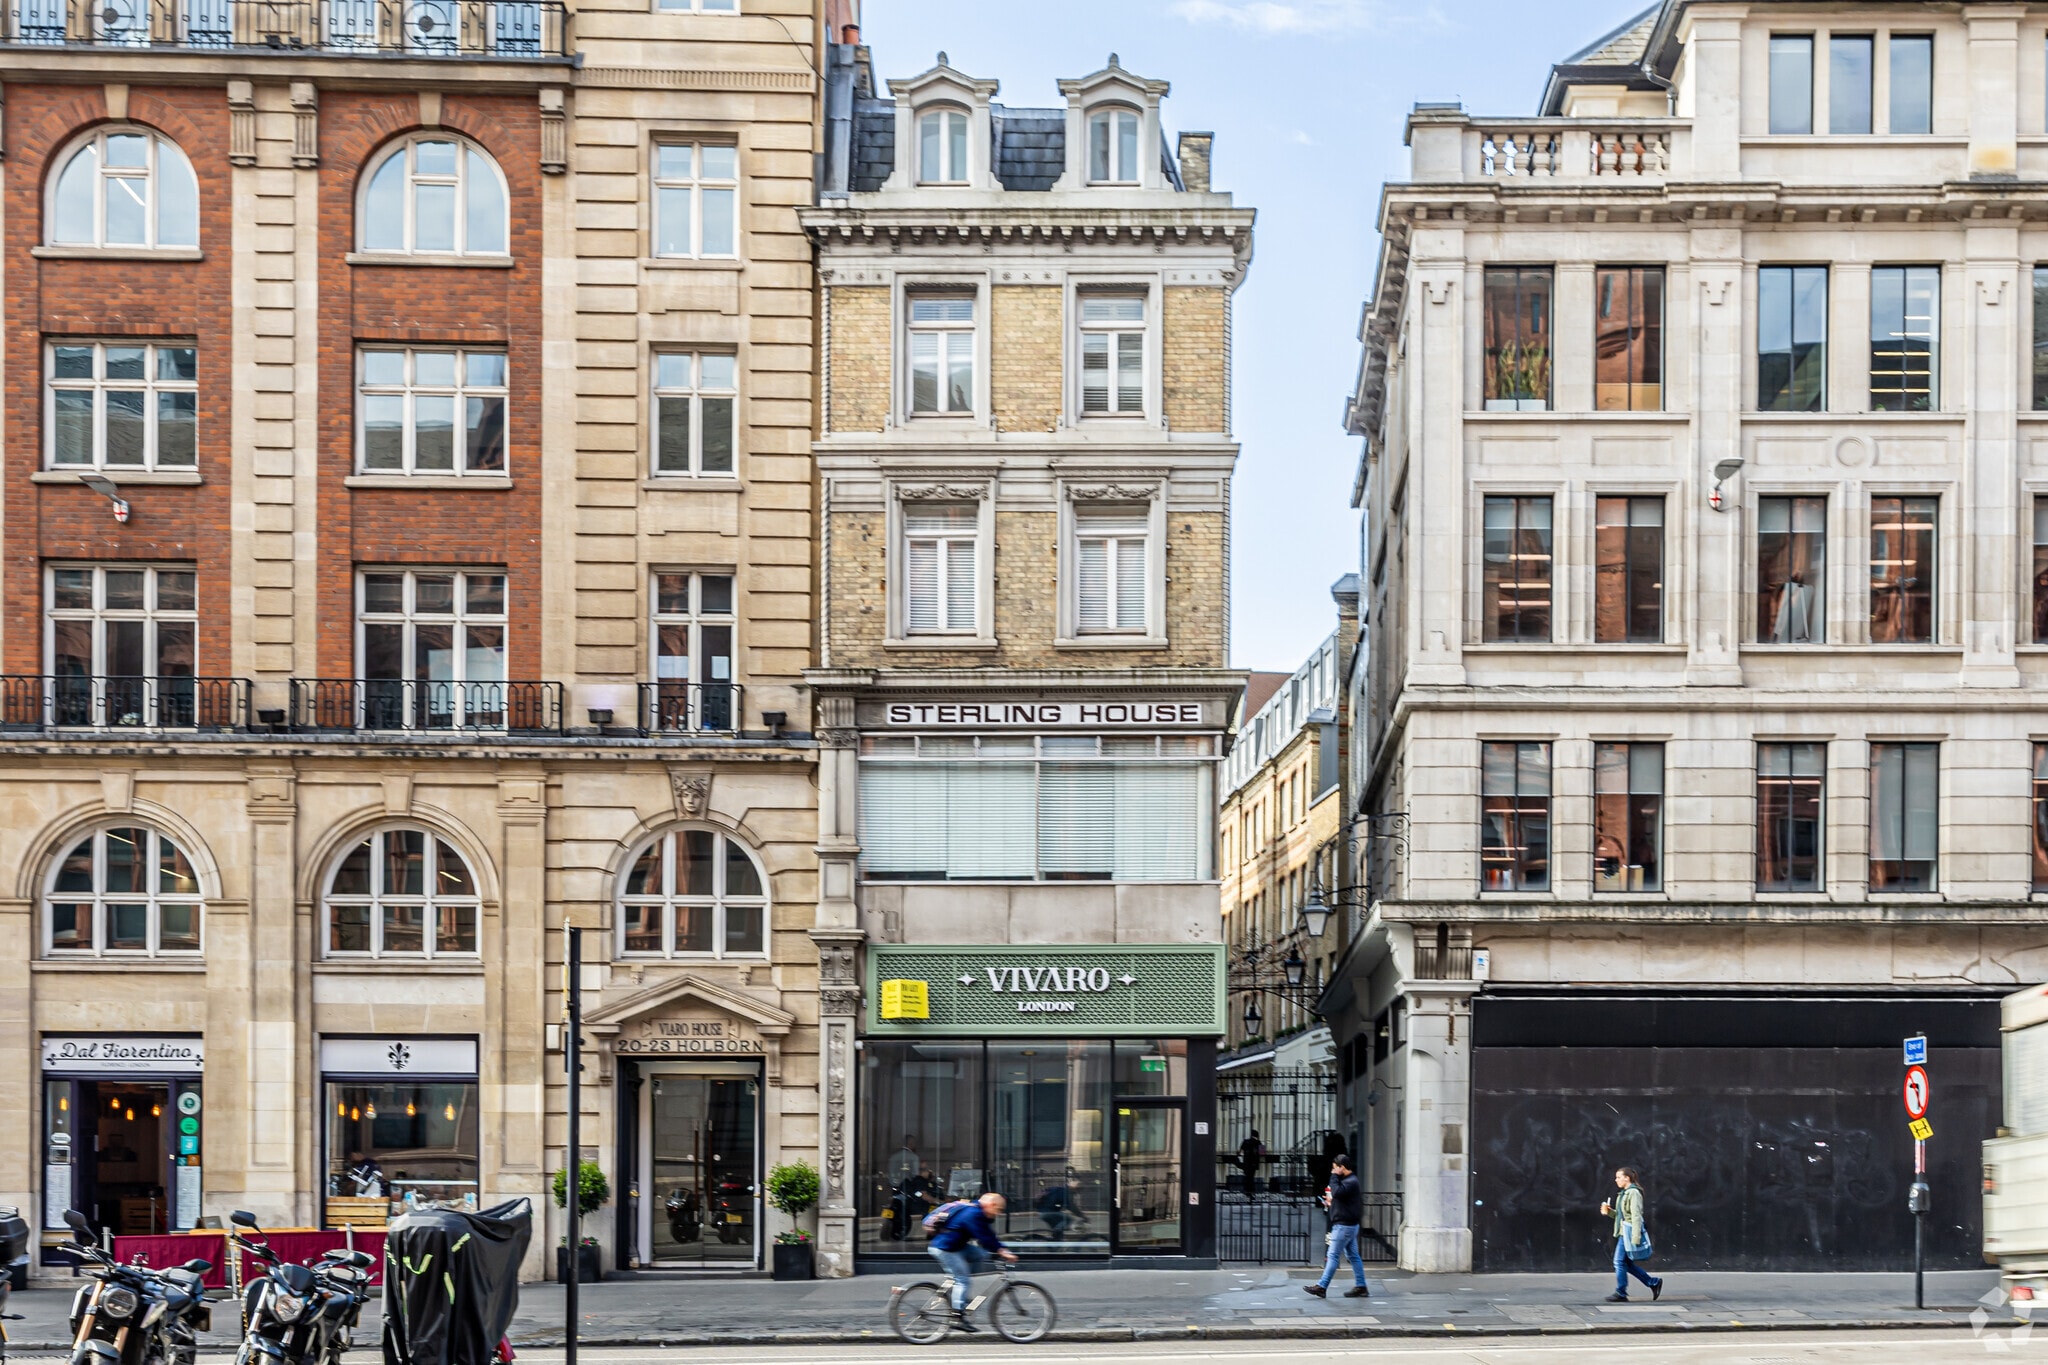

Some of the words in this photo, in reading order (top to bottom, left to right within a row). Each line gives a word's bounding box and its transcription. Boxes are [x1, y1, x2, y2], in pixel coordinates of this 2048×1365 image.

[890, 705, 1061, 723] STERLING
[1080, 705, 1199, 722] HOUSE
[986, 967, 1110, 992] VIVARO
[1017, 1001, 1076, 1012] LONDON
[658, 1022, 689, 1036] VIARO
[692, 1023, 723, 1036] HOUSE
[60, 1042, 98, 1058] Dal
[102, 1042, 192, 1058] Fiorentino
[677, 1040, 764, 1052] HOLBORN
